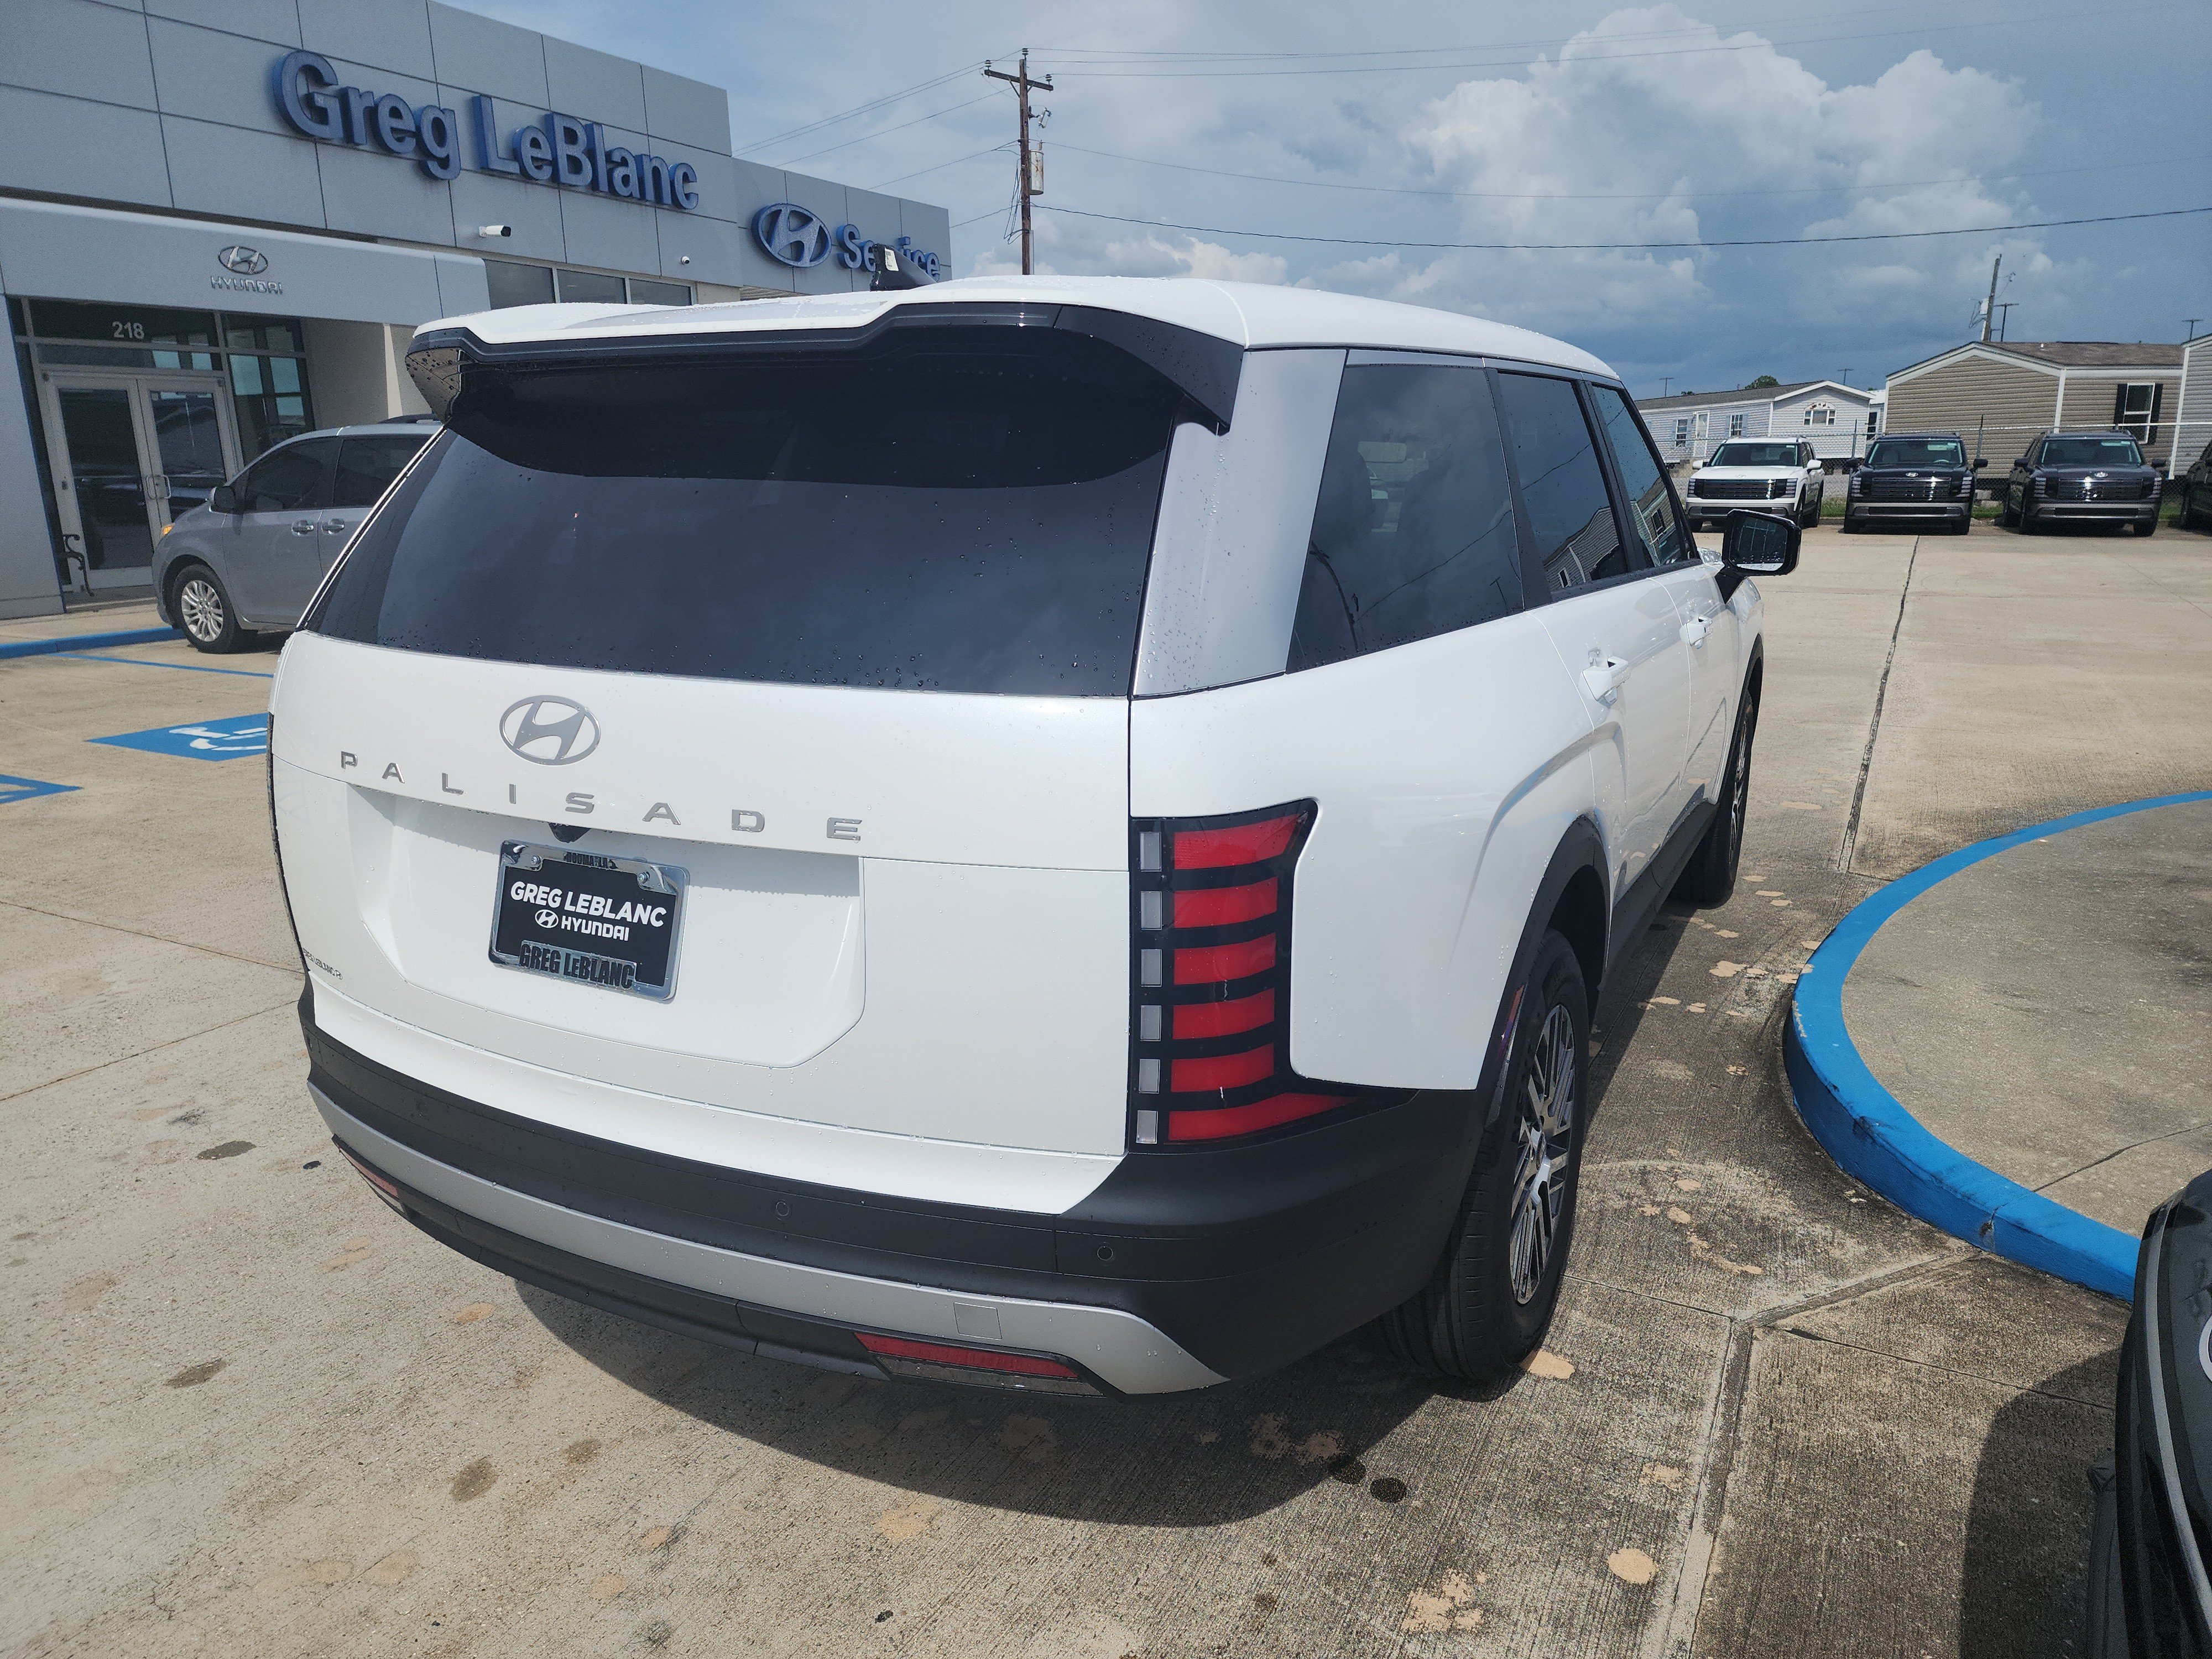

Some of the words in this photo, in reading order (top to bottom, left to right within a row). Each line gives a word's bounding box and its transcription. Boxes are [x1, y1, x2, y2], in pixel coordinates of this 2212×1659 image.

[272, 50, 461, 180] Greg
[472, 95, 698, 210] LeBlanc
[836, 225, 940, 282] Seice
[210, 276, 283, 295] HYUNDAI
[112, 321, 145, 339] 218
[341, 751, 862, 841] PALISADE
[511, 881, 562, 908] GREG
[564, 892, 666, 927] LEBLANC
[561, 916, 629, 941] HYUNDAI
[519, 944, 561, 973] GREG
